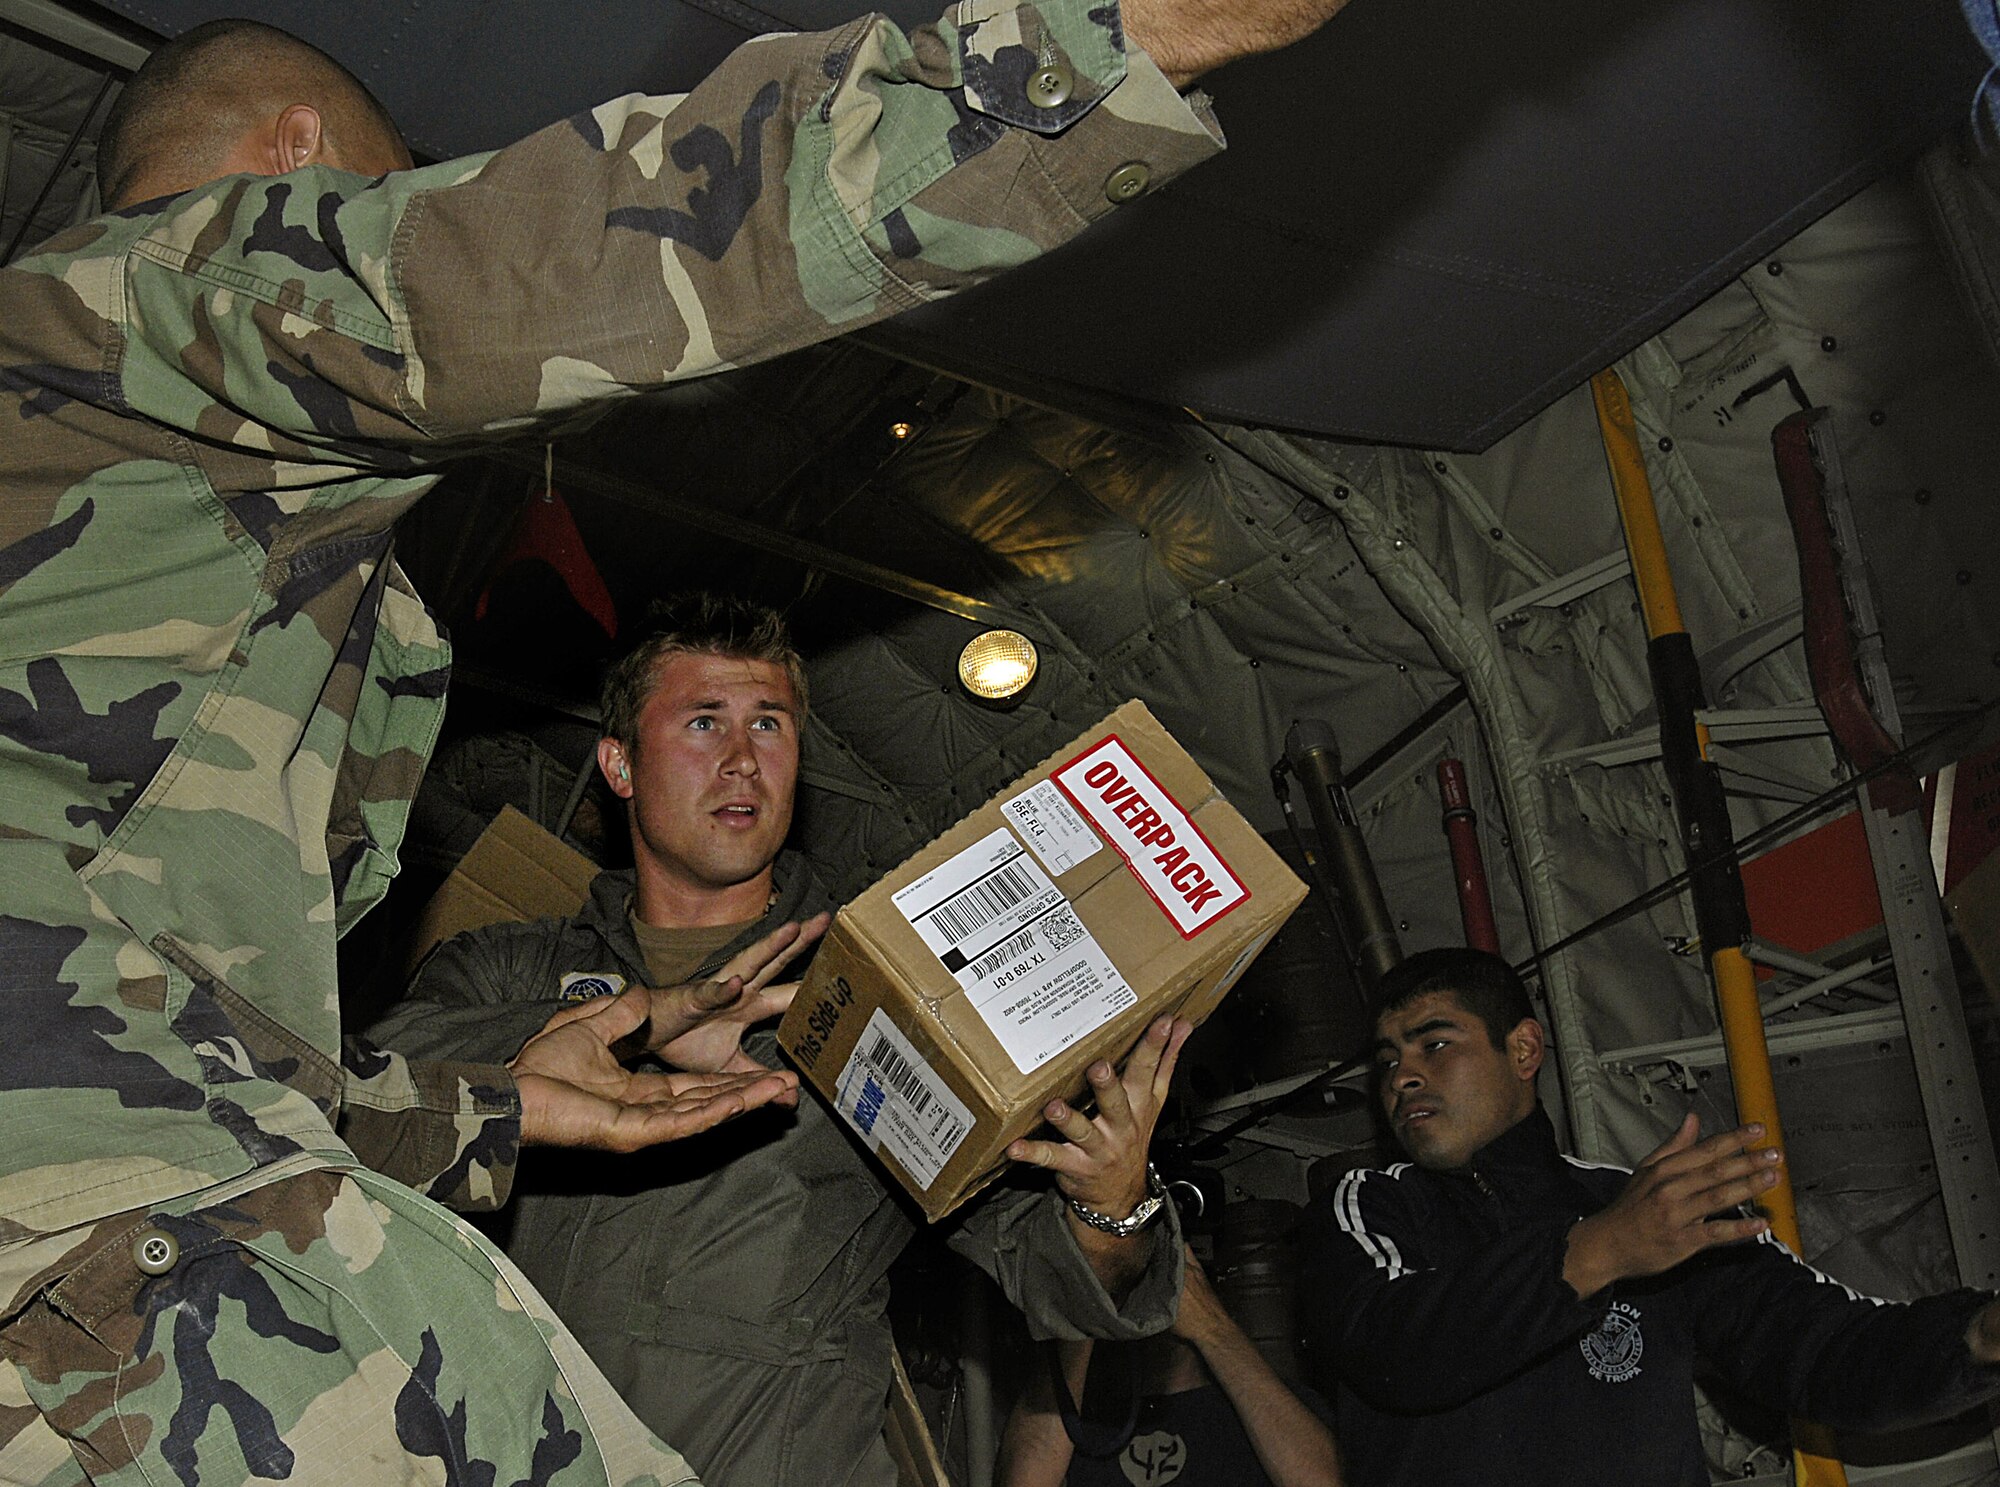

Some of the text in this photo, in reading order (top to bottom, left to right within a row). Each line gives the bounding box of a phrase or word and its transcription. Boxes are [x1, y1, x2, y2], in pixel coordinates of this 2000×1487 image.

[1010, 799, 1045, 837] 05E-FL4
[1023, 798, 1039, 814] BLUE
[1079, 755, 1226, 915] OVERPACK
[1043, 890, 1061, 906] UPS
[1015, 900, 1047, 923] GROUND
[990, 950, 1046, 991] TX 769 0-01
[1050, 957, 1088, 986] GOODFELLOW
[1030, 988, 1041, 998] TX
[1040, 980, 1054, 992] AFB
[793, 976, 855, 1071] This Side Up
[1588, 1366, 1643, 1384] DE TROPA
[1128, 1440, 1179, 1481] 42
